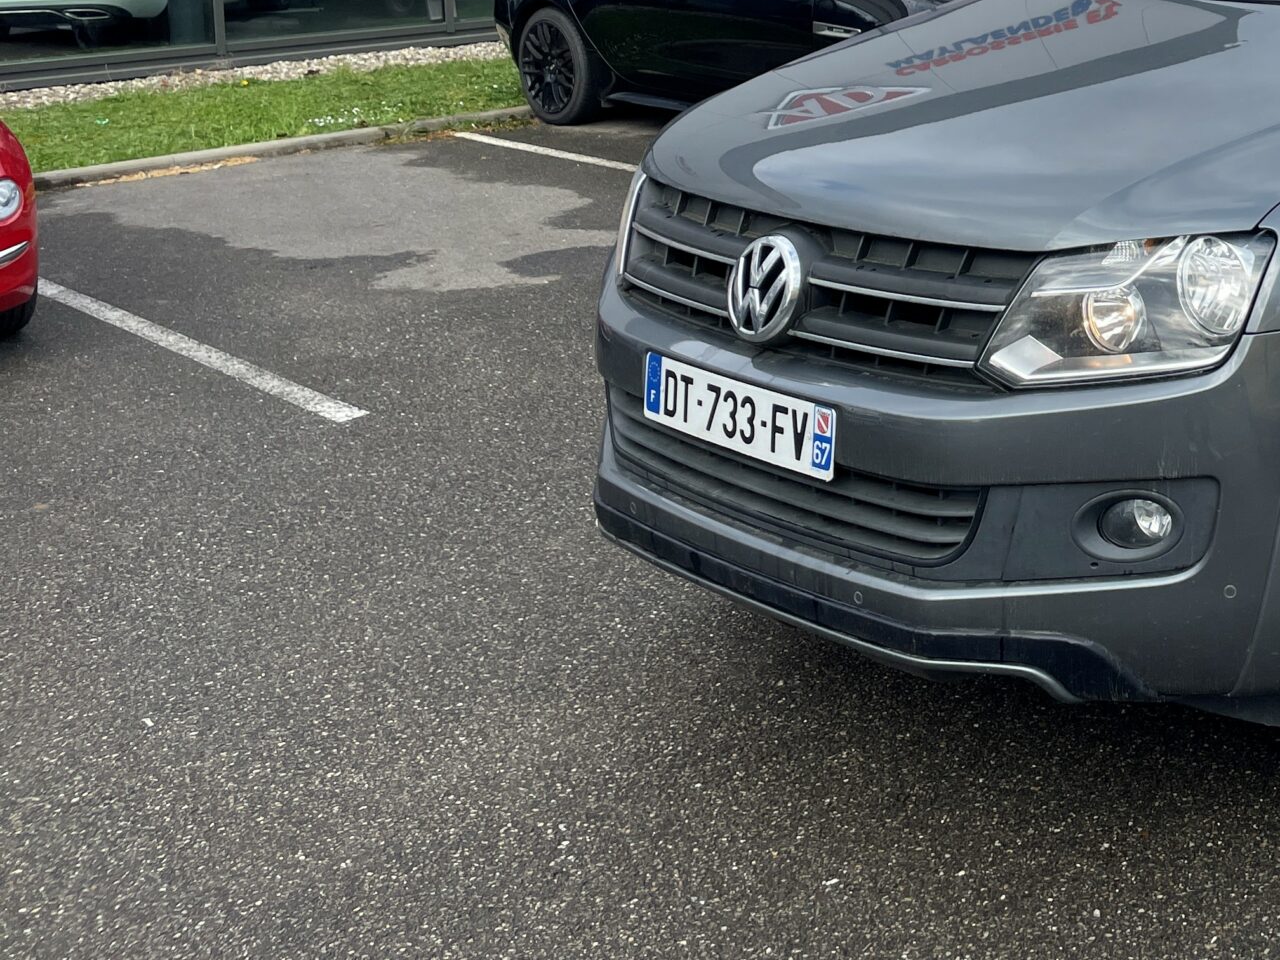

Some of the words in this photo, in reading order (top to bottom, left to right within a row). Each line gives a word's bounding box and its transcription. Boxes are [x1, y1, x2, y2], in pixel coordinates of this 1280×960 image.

[649, 389, 656, 403] F
[663, 368, 809, 462] DT-733-FV
[813, 440, 831, 466] 67
